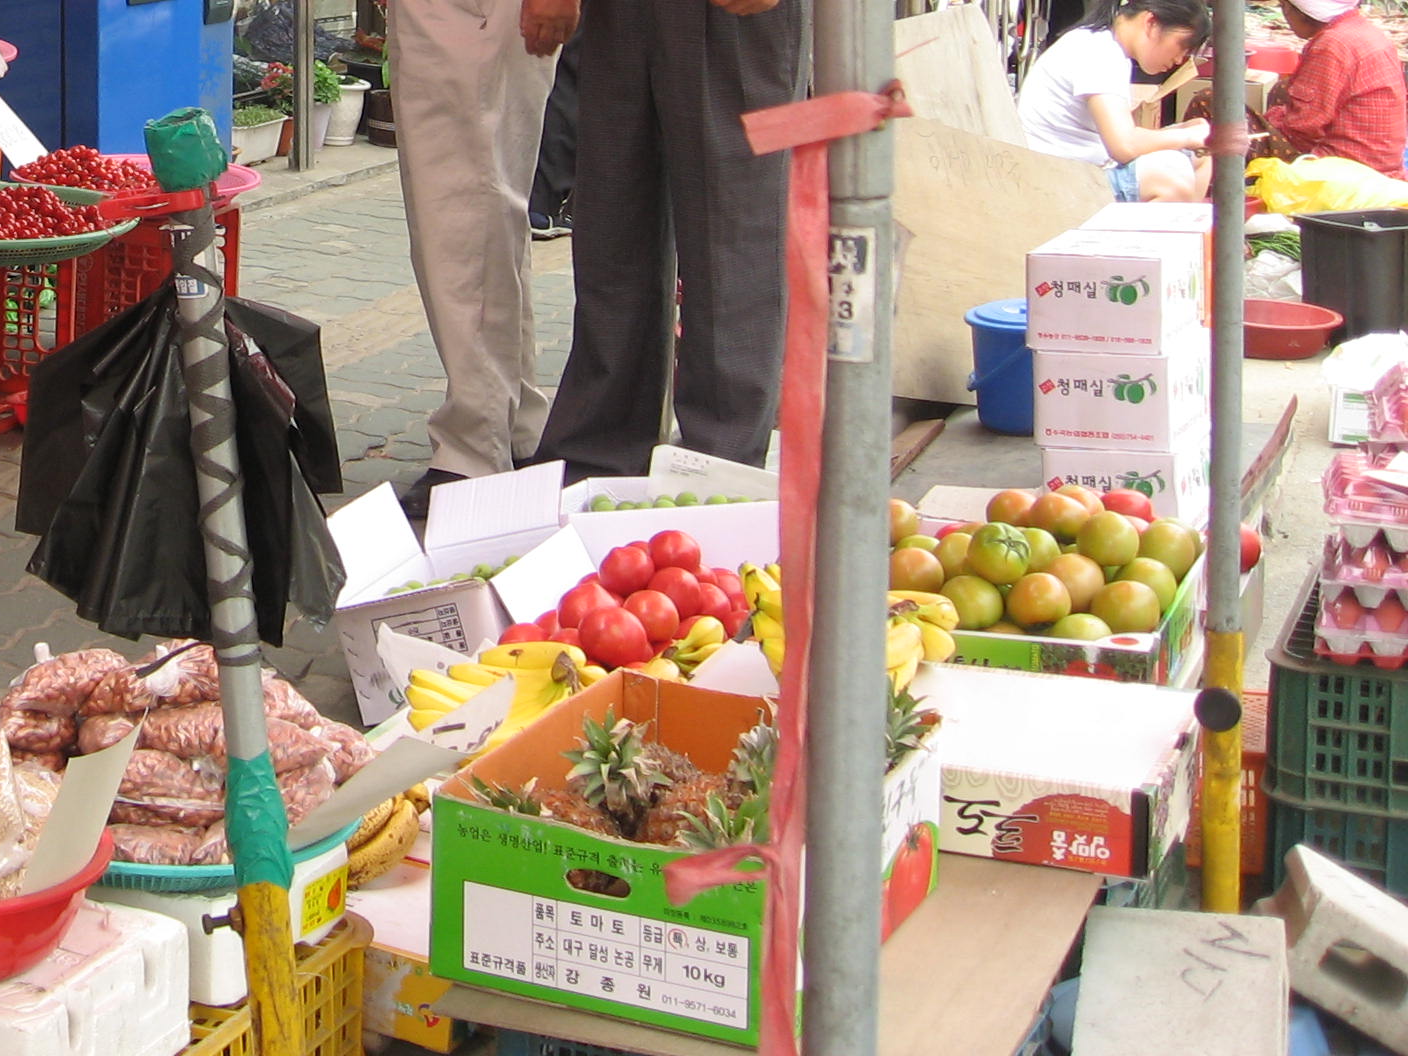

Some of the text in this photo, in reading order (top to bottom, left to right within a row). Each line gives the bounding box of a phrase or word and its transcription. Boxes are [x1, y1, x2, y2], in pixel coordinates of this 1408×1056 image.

[1051, 280, 1096, 299] 청매실
[1057, 379, 1103, 397] 청매실
[457, 824, 491, 843] 농업은
[554, 845, 600, 863] 표준규격
[535, 903, 555, 922] 품목
[643, 925, 664, 944] 등급
[715, 941, 739, 958] 보통
[470, 951, 526, 976] 표준규격품
[535, 932, 555, 951] 주소
[563, 939, 583, 957] 대구
[589, 944, 609, 963] 달성
[614, 949, 634, 968] 논공
[643, 955, 663, 974] 무게
[535, 961, 556, 981] 생산자
